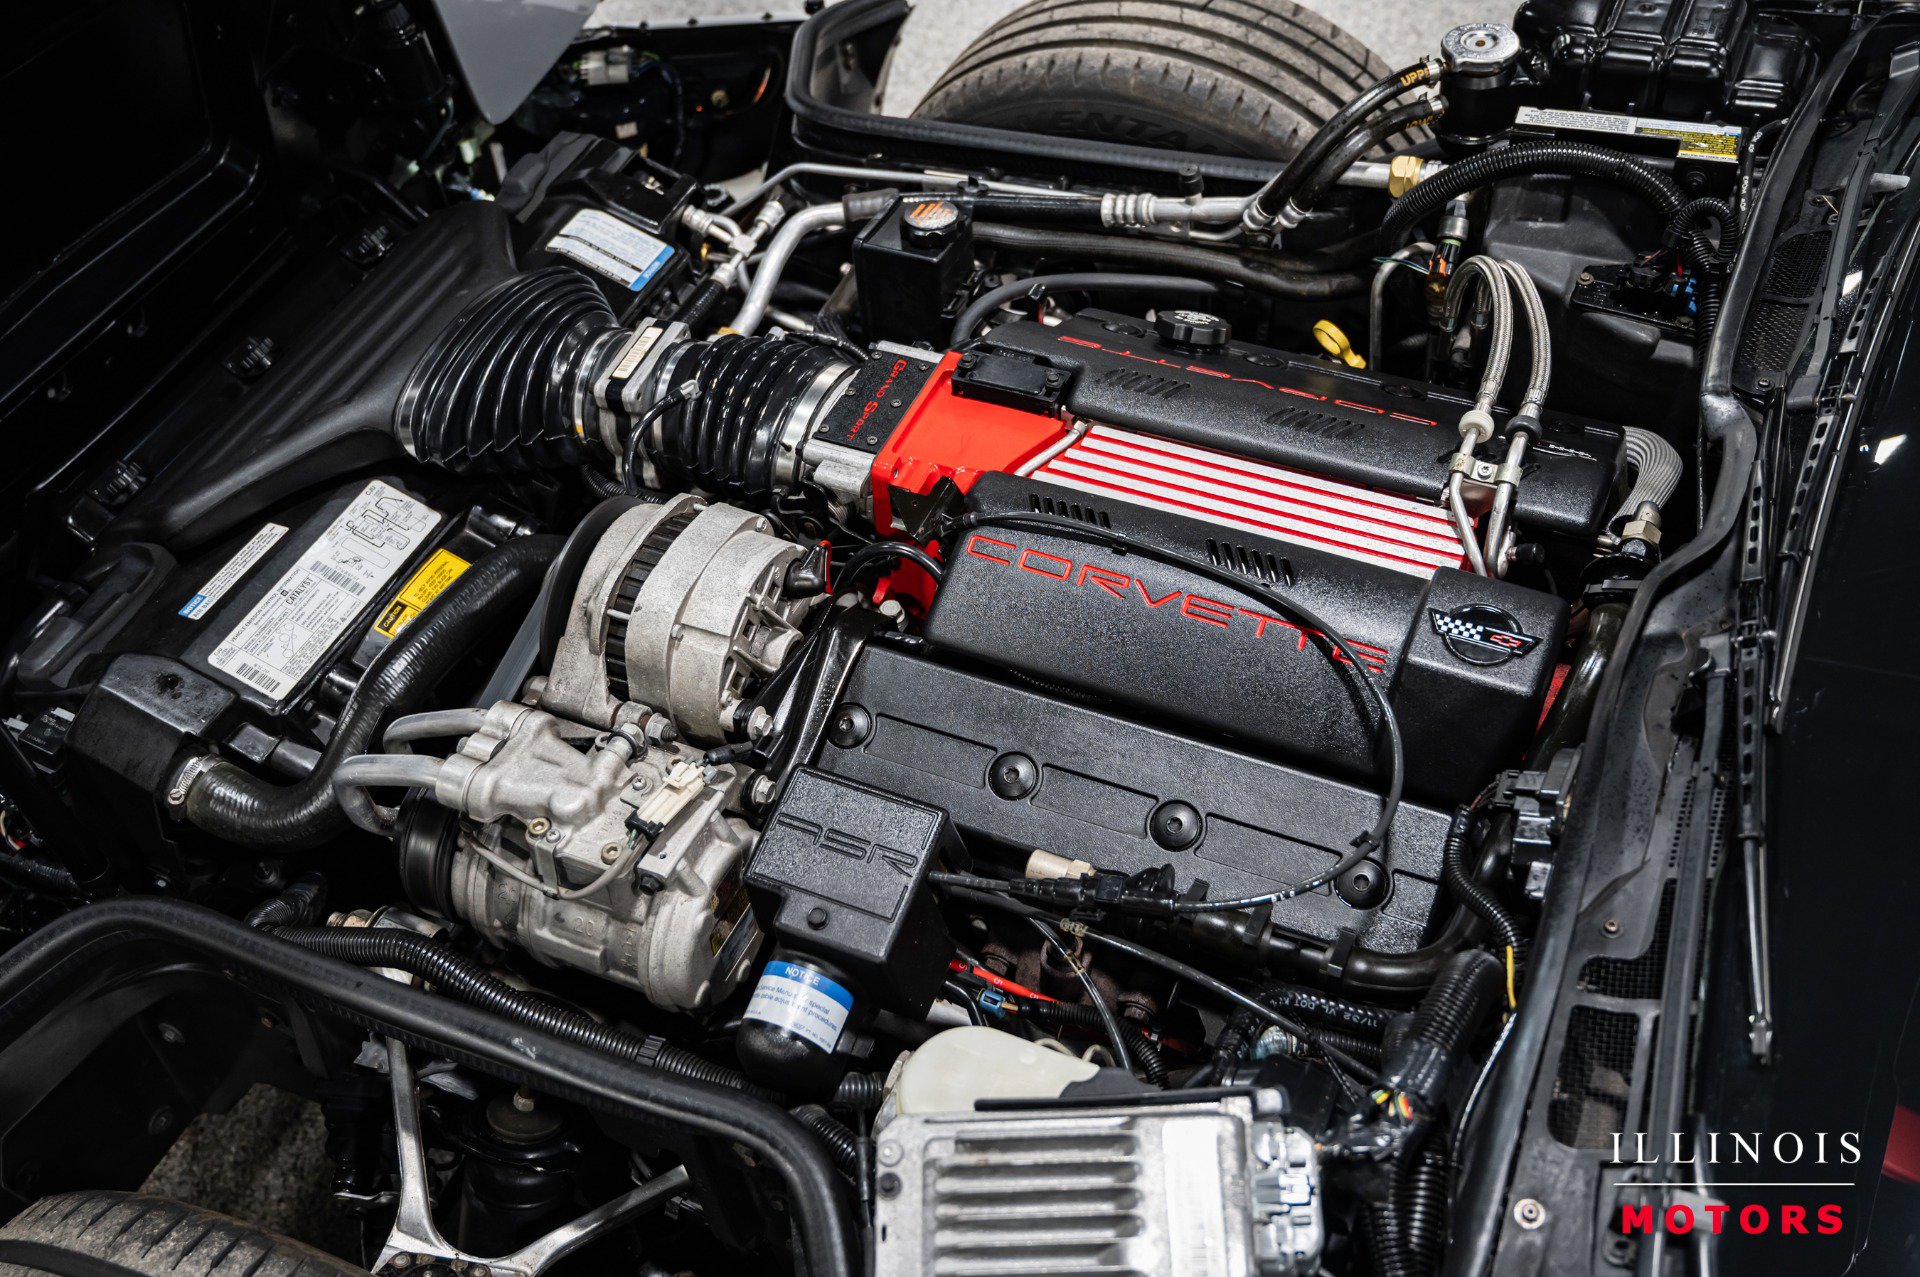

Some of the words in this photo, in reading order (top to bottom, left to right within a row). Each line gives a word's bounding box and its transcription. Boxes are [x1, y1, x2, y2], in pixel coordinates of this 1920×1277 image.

[872, 359, 907, 404] GRAND
[849, 402, 878, 439] SPORT
[285, 576, 313, 605] CATALYST
[383, 606, 403, 627] CAUTION
[966, 534, 1388, 674] CORVETTE
[769, 812, 919, 879] ASR
[784, 965, 820, 985] NOTICE
[807, 999, 831, 1014] special
[1293, 997, 1316, 1010] DOT
[1342, 1011, 1378, 1027] 11/32
